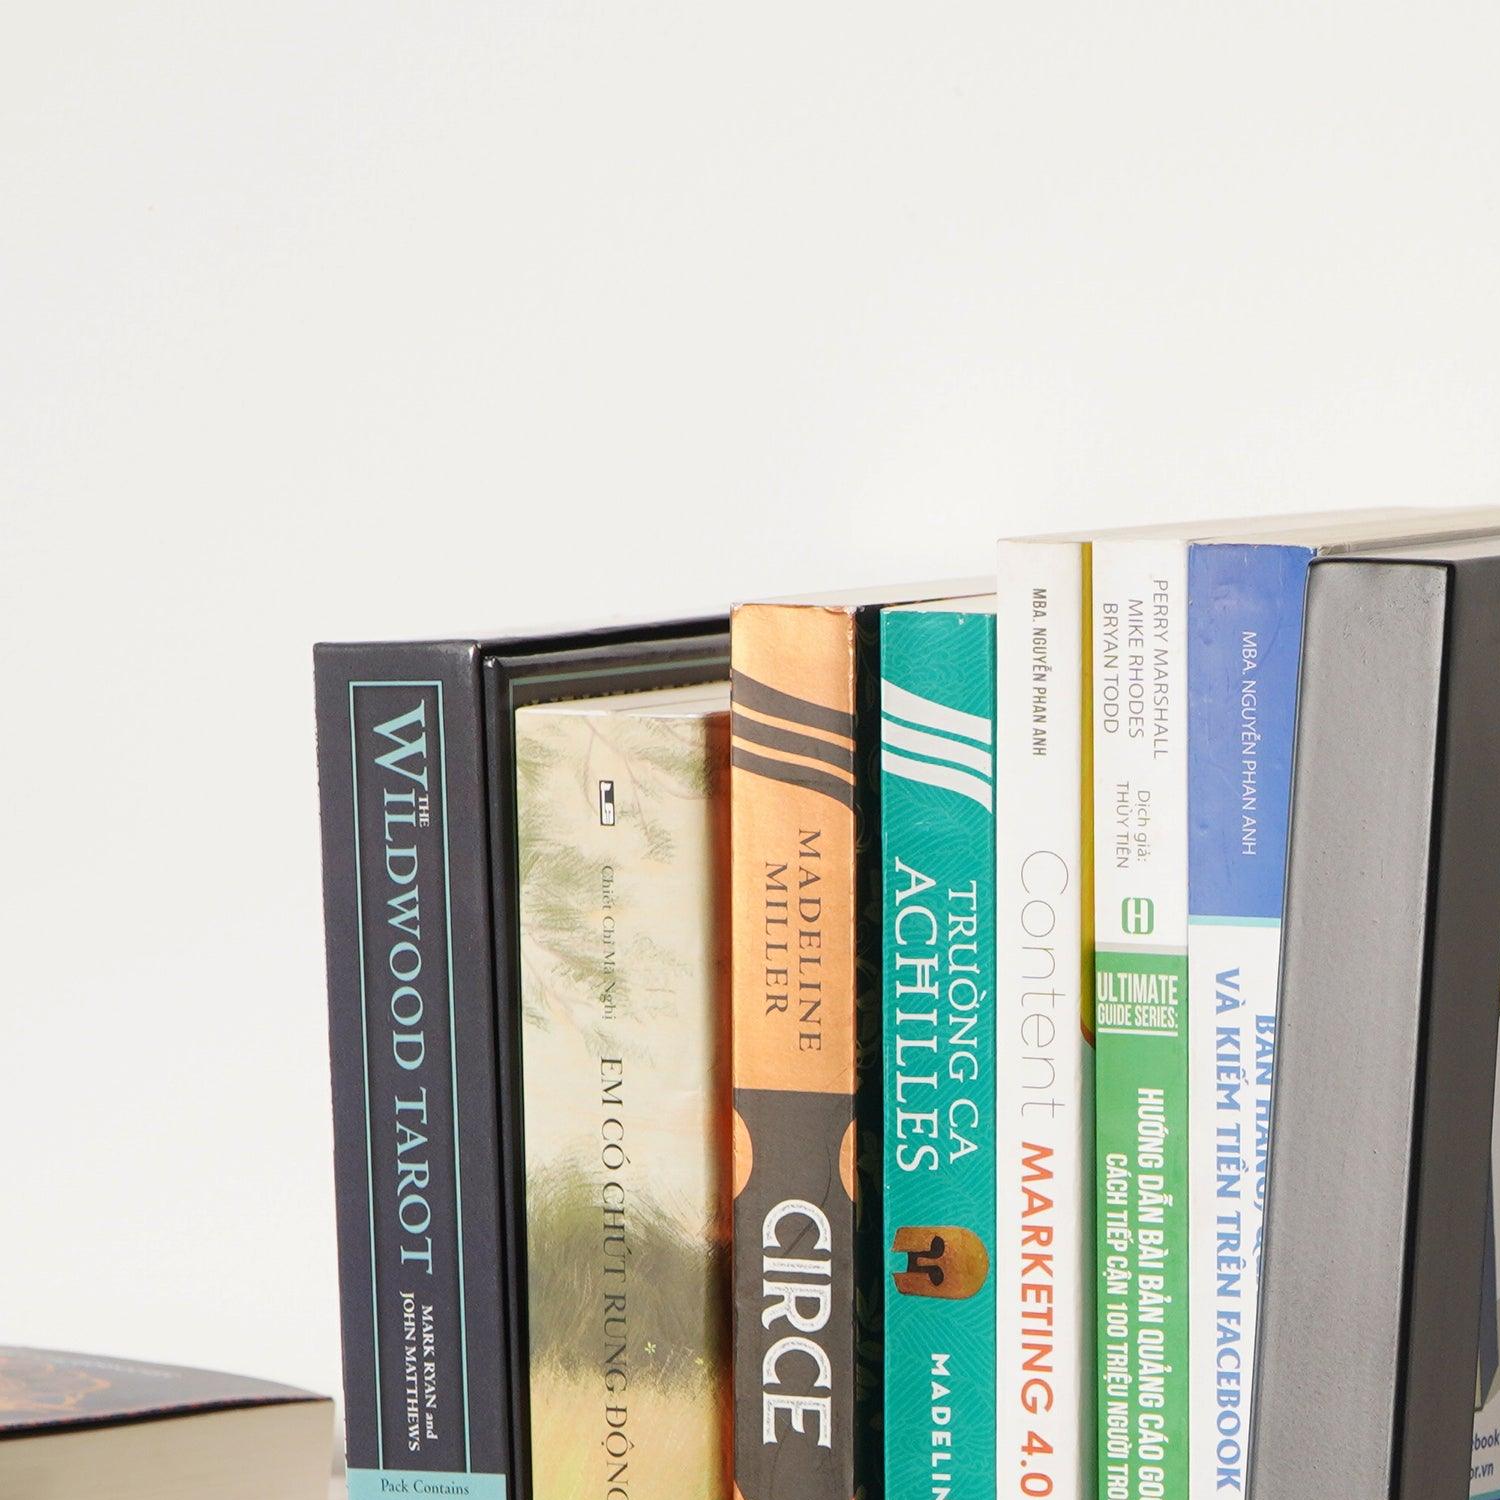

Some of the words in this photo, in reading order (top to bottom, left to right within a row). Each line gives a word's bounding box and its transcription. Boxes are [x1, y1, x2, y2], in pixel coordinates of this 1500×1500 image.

[1032, 587, 1047, 622] MBA.
[1128, 598, 1144, 648] MIKE
[1153, 579, 1169, 643] PERRY
[1032, 627, 1052, 682] NGUYỄN
[1103, 602, 1119, 668] BRYAN
[1241, 631, 1257, 674] MBA.
[1032, 687, 1047, 724] PHAN
[1103, 674, 1119, 734] TODD
[1128, 654, 1145, 739] RHODES
[1153, 648, 1169, 760] MARSHALL
[1241, 680, 1261, 755] NGUYỄN
[1032, 727, 1047, 756] ANH
[418, 794, 429, 827] THE
[1133, 790, 1151, 827] Dịch
[1241, 760, 1257, 811] PHAN
[1115, 832, 1132, 869] TIÊN
[1241, 815, 1257, 856] ANH
[372, 699, 428, 1071] WILDWOOD
[765, 861, 789, 1017] MILLER
[798, 828, 822, 1053] MADELINE
[947, 879, 986, 1084] TRƯỜNG
[1021, 850, 1069, 1119] Content
[1097, 971, 1178, 1006] ULTIMATE
[1215, 966, 1246, 1016] VÀ
[895, 856, 939, 1172] ACHILLES
[1097, 1003, 1132, 1026] GUIDE
[1134, 1005, 1178, 1029] SERIES:
[600, 1056, 624, 1107] EM
[1216, 1027, 1249, 1112] KIẾM
[601, 1117, 630, 1170] CÓ
[948, 1098, 979, 1165] CA
[1137, 1087, 1170, 1169] HƯỚNG
[395, 1087, 433, 1275] TAROT
[1106, 1153, 1132, 1205] CÁCH
[1216, 1122, 1249, 1199] TIỀN
[1137, 1174, 1173, 1224] DẪN
[602, 1181, 632, 1284] CHÚT
[1106, 1210, 1135, 1252] TIẾP
[1137, 1228, 1169, 1268] BÀI
[1216, 1210, 1247, 1298] TRÊN
[1021, 1141, 1054, 1415] MARKETING
[1102, 1255, 1133, 1295] CẬN
[1137, 1274, 1172, 1323] BẢN
[400, 1290, 416, 1341] JOHN
[421, 1304, 435, 1357] MARK
[602, 1291, 629, 1394] RUNG
[762, 1198, 832, 1449] CIRCE
[1106, 1301, 1129, 1338] 100
[424, 1361, 437, 1409] RYAN
[1103, 1342, 1133, 1398] TRIỆU
[1137, 1328, 1173, 1408] QUẢNG
[405, 1345, 421, 1452] MATTHEWS
[1216, 1309, 1242, 1493] FACEBOOK
[425, 1412, 438, 1440] and
[1107, 1401, 1133, 1459] NGƯỜI
[1137, 1413, 1169, 1461] CÁO
[1471, 1429, 1500, 1451] book
[380, 1479, 409, 1493] Pack
[413, 1479, 471, 1495] Contains
[1020, 1430, 1054, 1498] 4.0
